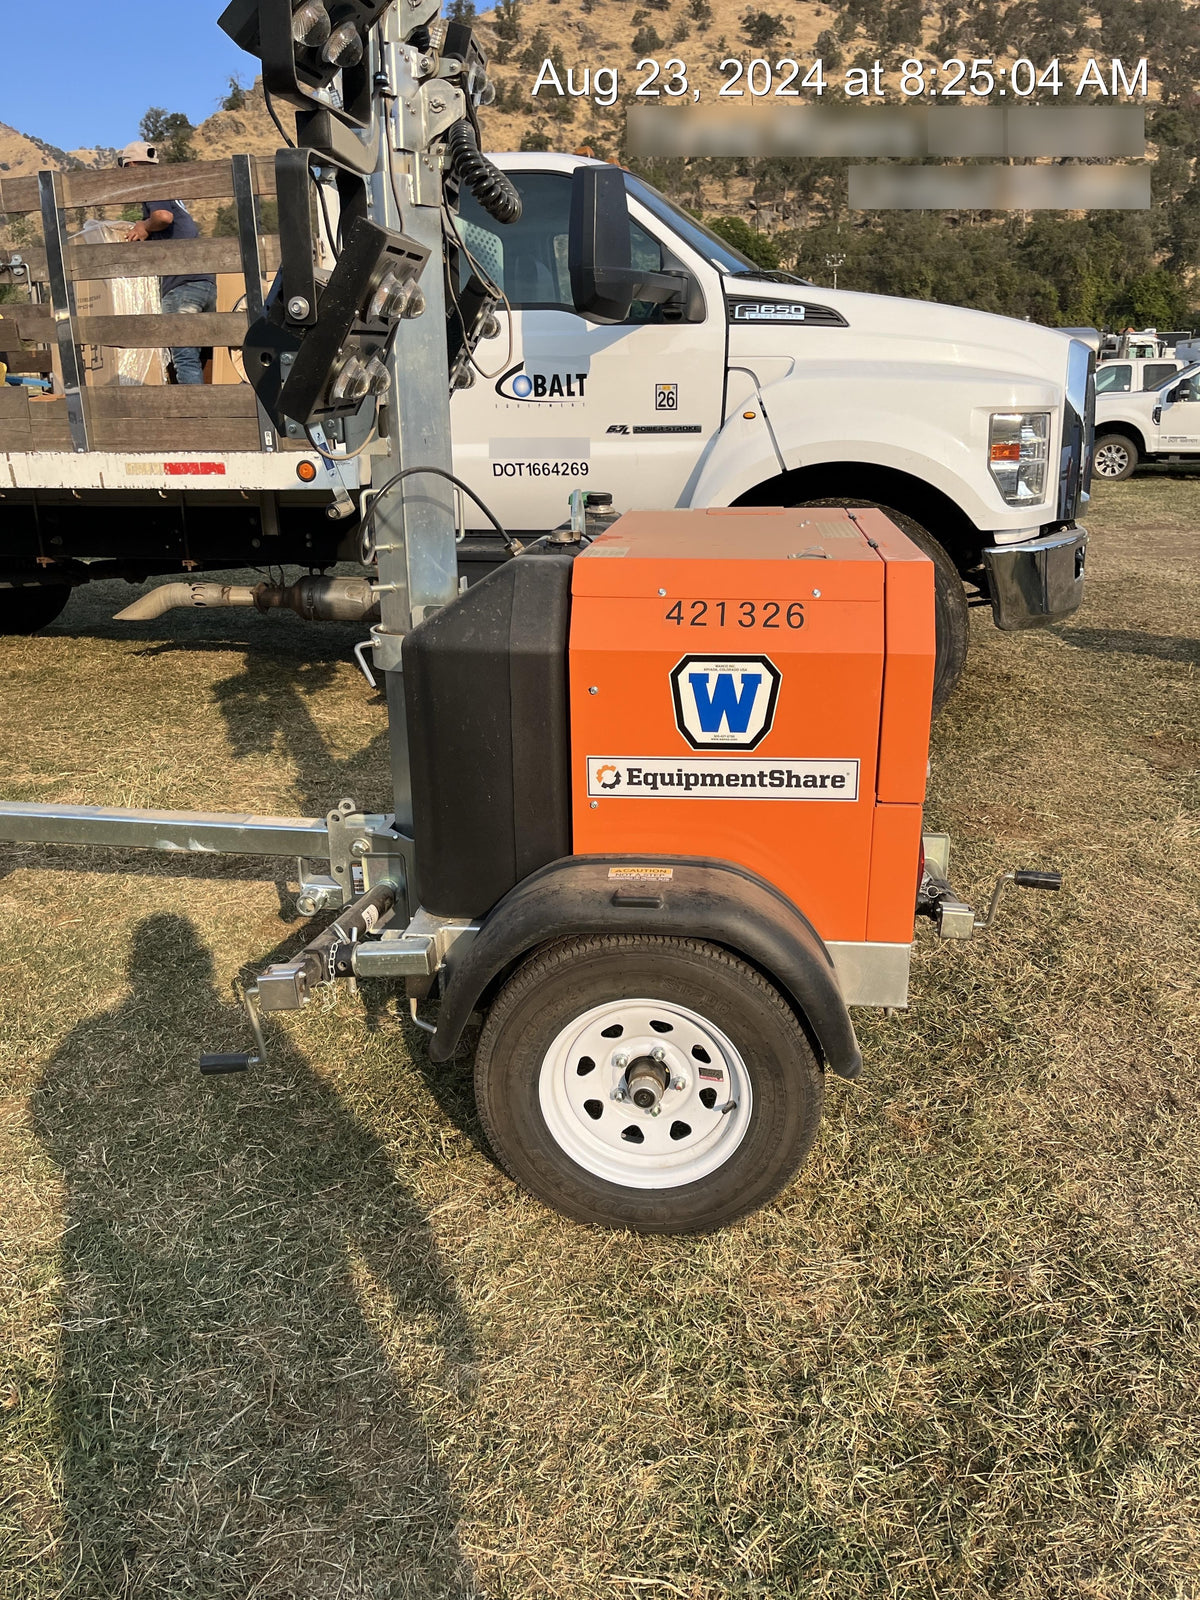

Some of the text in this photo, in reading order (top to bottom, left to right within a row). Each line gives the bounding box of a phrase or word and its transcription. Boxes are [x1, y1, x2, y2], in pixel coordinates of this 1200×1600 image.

[658, 391, 675, 407] 26
[492, 462, 589, 476] DOT1664269
[665, 600, 805, 629] 421326
[689, 673, 762, 733] W
[627, 768, 846, 790] EquipmentShare
